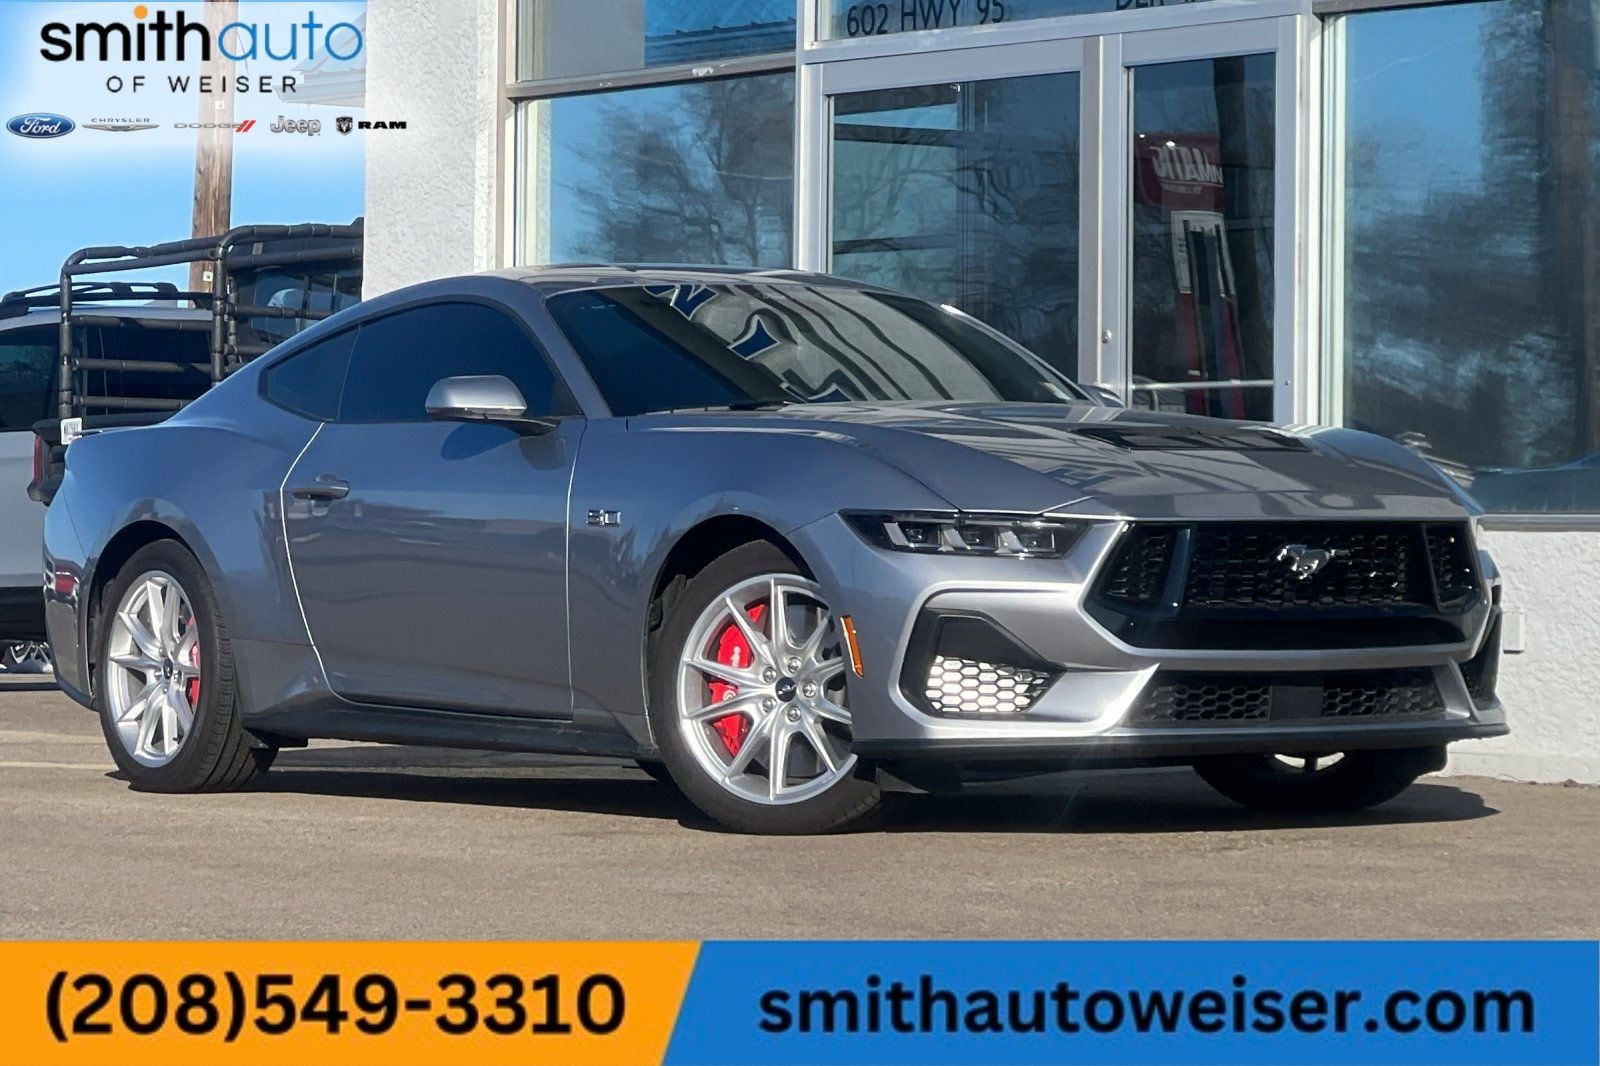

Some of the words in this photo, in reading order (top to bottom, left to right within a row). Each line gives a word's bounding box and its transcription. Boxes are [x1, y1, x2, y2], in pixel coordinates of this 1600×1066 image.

[846, 4, 888, 36] 602
[900, 0, 962, 31] HWY
[976, 0, 1005, 25] 95
